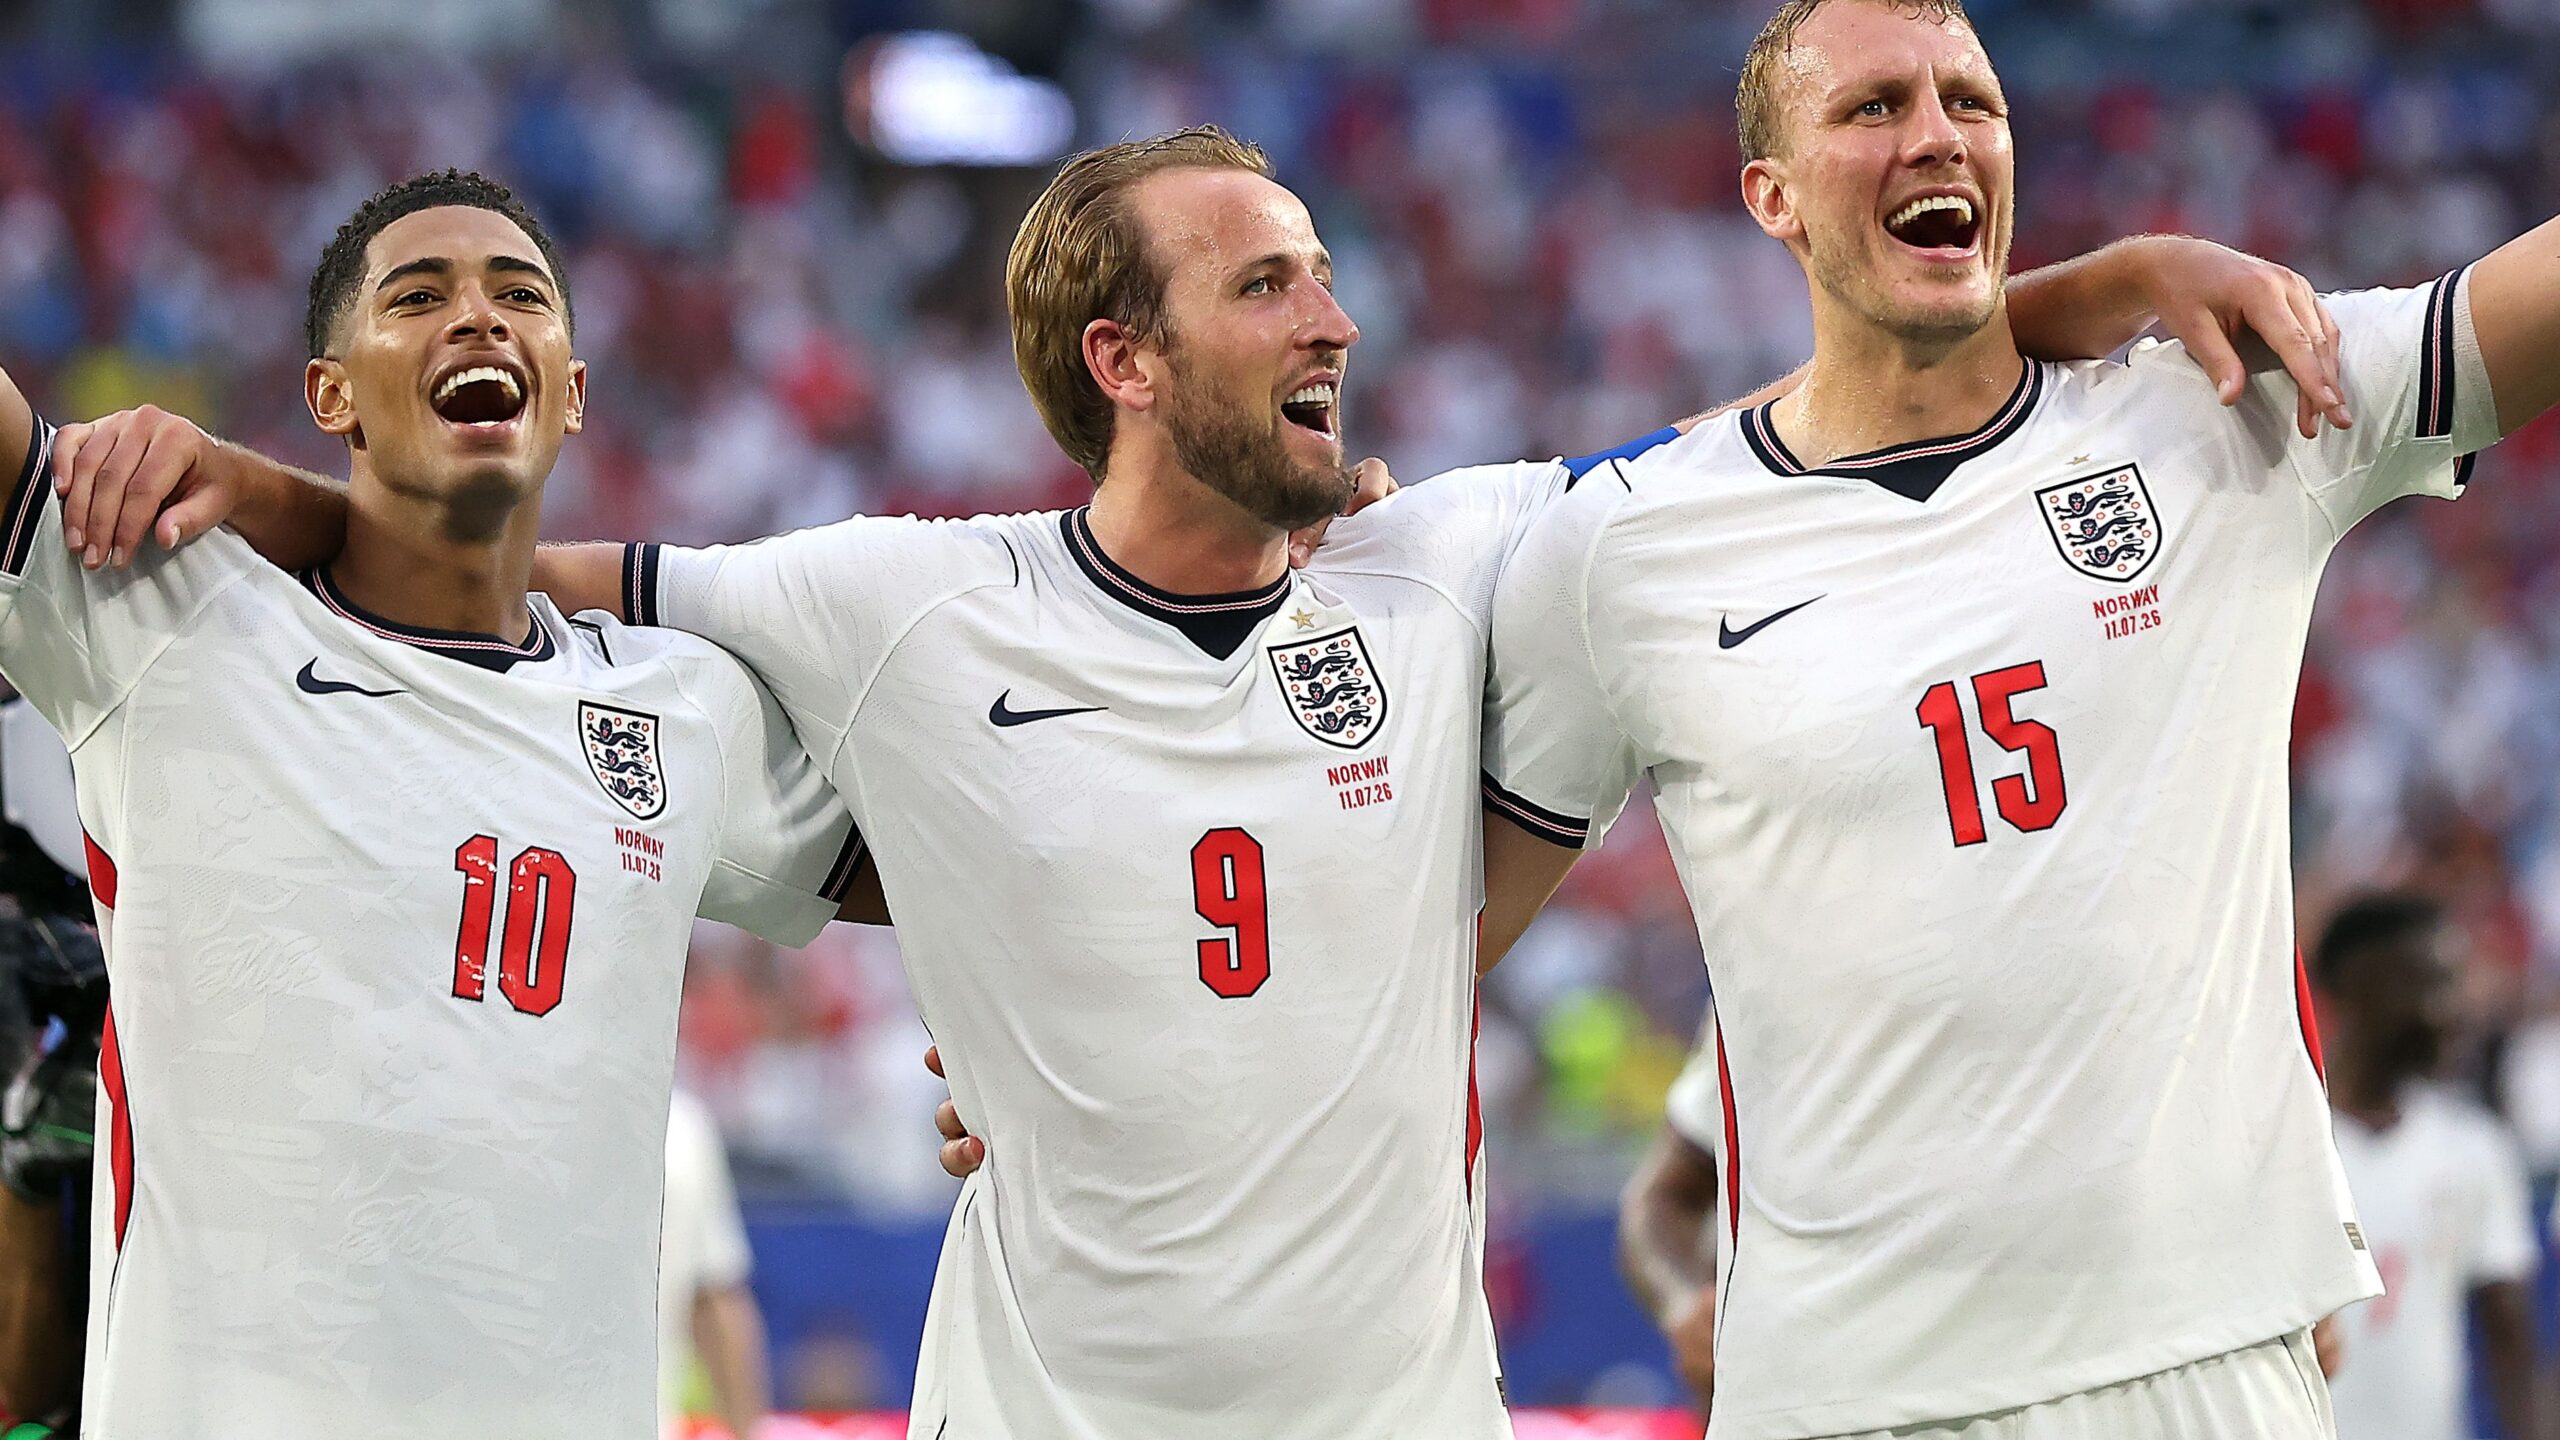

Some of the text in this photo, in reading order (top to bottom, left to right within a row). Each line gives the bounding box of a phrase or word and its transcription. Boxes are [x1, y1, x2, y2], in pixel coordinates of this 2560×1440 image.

[2093, 584, 2159, 619] NORWAY
[2105, 609, 2161, 640] 11.07.26
[1327, 755, 1389, 787] NORWAY
[1916, 660, 2067, 848] 15
[1339, 782, 1392, 810] 11.07.26
[614, 826, 664, 860] NORWAY
[452, 833, 577, 1018] 10
[1190, 826, 1270, 999] 9
